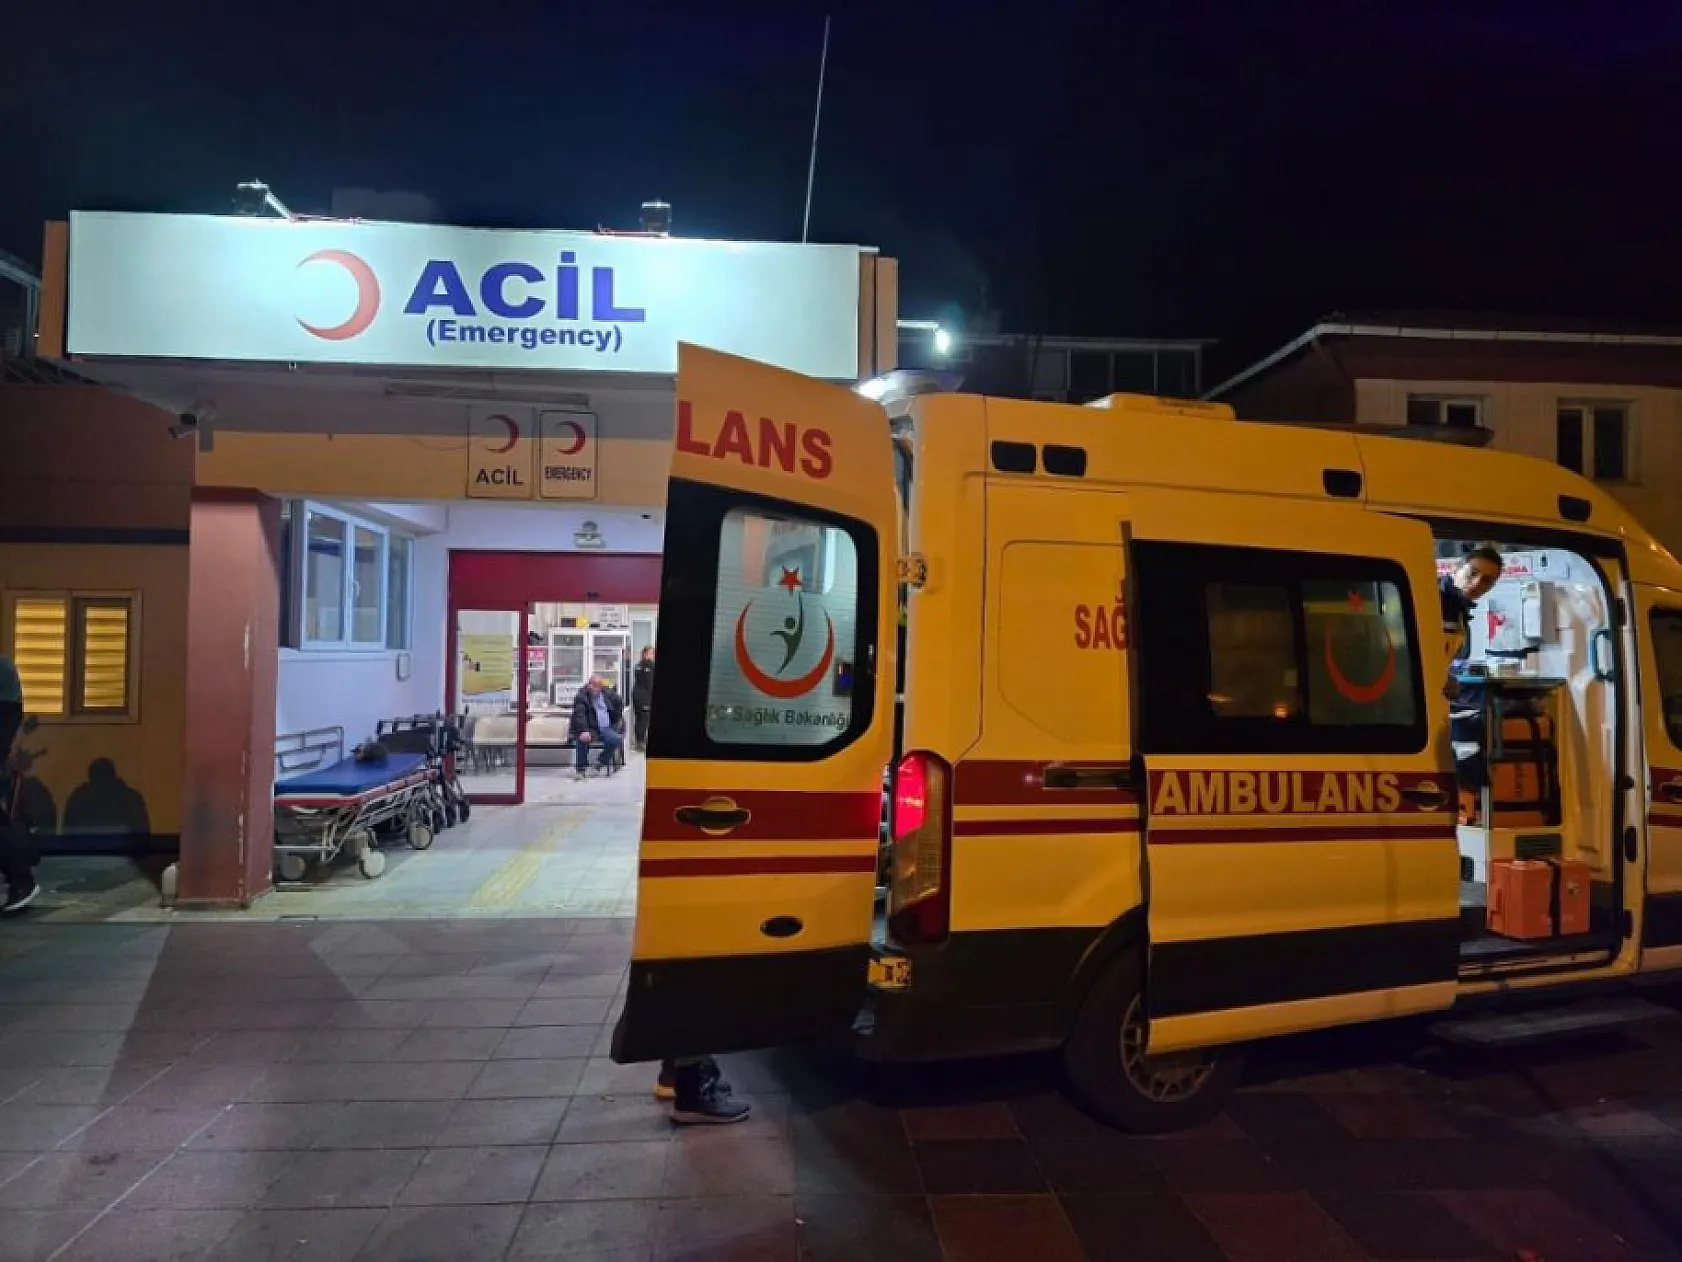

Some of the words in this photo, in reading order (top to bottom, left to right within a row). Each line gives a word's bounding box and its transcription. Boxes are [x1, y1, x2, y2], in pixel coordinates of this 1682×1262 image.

[403, 250, 646, 322] ACİL
[427, 319, 622, 352] (Emergency)
[676, 400, 833, 479] LANS
[475, 465, 524, 485] ACİL
[1153, 770, 1400, 814] AMBULANS
